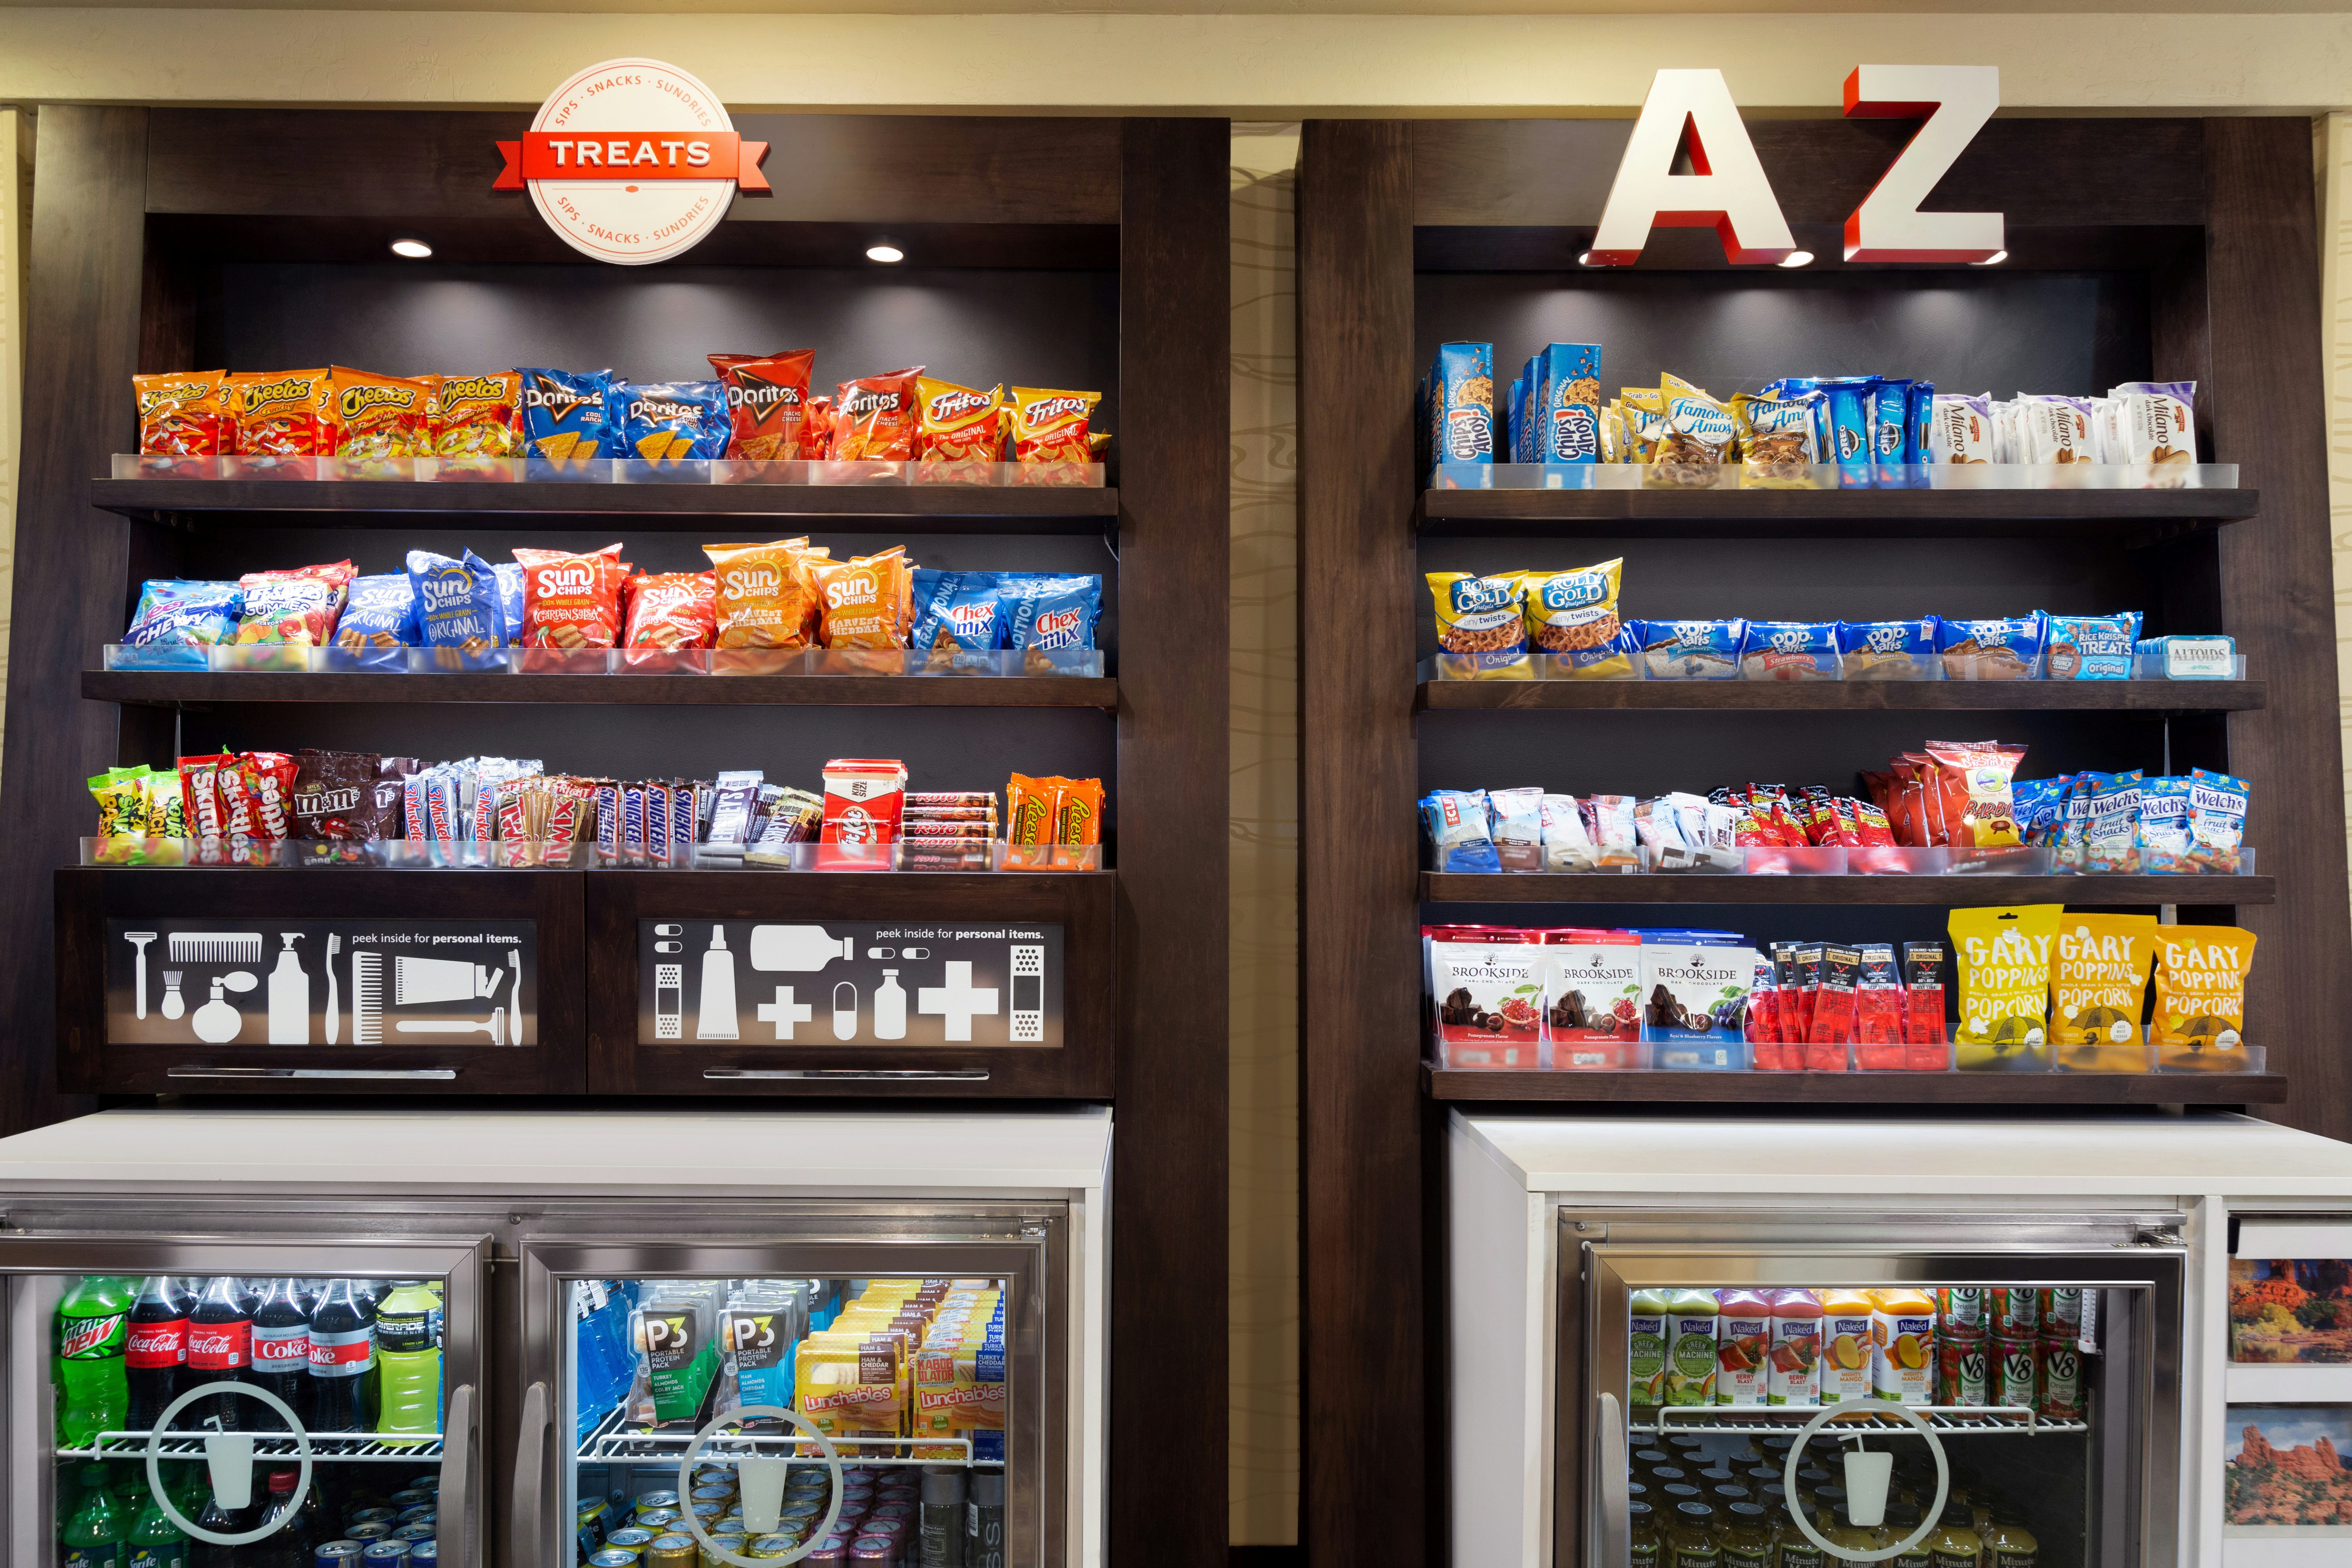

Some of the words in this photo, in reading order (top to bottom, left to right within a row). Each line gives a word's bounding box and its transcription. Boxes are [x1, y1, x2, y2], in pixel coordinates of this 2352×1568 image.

[556, 100, 578, 126] SIPS
[587, 75, 642, 96] SNACKS
[656, 80, 711, 127] SUNDRIES
[549, 140, 710, 167] TREATS
[1586, 68, 1797, 265] A
[1844, 64, 2004, 262] Z
[557, 197, 579, 221] SIPS
[588, 223, 640, 243] SNACKS
[653, 196, 709, 240] SUNDRIES
[1668, 379, 1681, 387] Grab
[140, 384, 210, 417] Cheetos
[244, 378, 312, 415] Cheetos
[527, 390, 603, 407] Doritos
[729, 386, 799, 406] Doritos
[259, 403, 294, 416] Crunchy
[1025, 397, 1087, 427] Fritos
[1669, 397, 1733, 423] Famous
[951, 426, 986, 439] ORIGINAL
[1686, 419, 1732, 435] Amos
[1947, 403, 1965, 452] Milano
[1840, 424, 1853, 460] OREO
[537, 569, 593, 598] Sun
[557, 586, 592, 595] CHIPS
[726, 570, 781, 600] Sun
[745, 586, 779, 597] CHIPS
[1548, 584, 1602, 608] GOLD
[952, 602, 996, 621] Chex
[1474, 603, 1494, 612] Pretzels
[1556, 614, 1570, 623] tiny
[1571, 610, 1599, 619] twists
[829, 617, 880, 628] HARVEST
[1776, 644, 1805, 654] tarts
[1871, 653, 1903, 662] S'mores
[2080, 642, 2132, 655] TREATS
[2173, 648, 2227, 662] ALTOIDS
[558, 784, 589, 798] RIGHT
[916, 794, 959, 802] Rolo
[2196, 790, 2244, 810] Welch's
[295, 788, 360, 815] m&m's
[2093, 791, 2139, 814] Welch's
[218, 770, 252, 862] Skittles
[647, 787, 667, 857] SNICKERS
[353, 933, 378, 944] peek
[381, 934, 411, 942] inside
[414, 933, 430, 942] for
[433, 934, 482, 945] personal
[486, 934, 521, 943] items.
[877, 929, 901, 940] peek
[904, 929, 934, 938] inside
[937, 929, 953, 938] for
[956, 930, 1005, 940] personal
[1009, 930, 1044, 939] items.
[1966, 935, 2051, 966] GARY
[2165, 943, 2238, 969] GARY
[1452, 967, 1528, 978] BROOKSIDE
[1564, 969, 1633, 980] BROOKSIDE
[1658, 968, 1737, 980] BROOKSIDE
[1969, 966, 2049, 989] POPPINS
[2060, 963, 2134, 980] POPPINS
[1966, 992, 2047, 1019] POPCORN
[2165, 996, 2241, 1016] POPCORN
[646, 1316, 688, 1350] P3
[734, 1316, 775, 1350] P3
[1684, 1322, 1710, 1332] Naked
[128, 1332, 181, 1352] Coca-Cola
[263, 1342, 307, 1358] Coke
[1686, 1341, 1707, 1350] GREEN
[651, 1348, 684, 1357] PORTABLE
[1960, 1348, 1984, 1379] V8
[2004, 1352, 2028, 1381] V8
[804, 1387, 893, 1411] Lunchables
